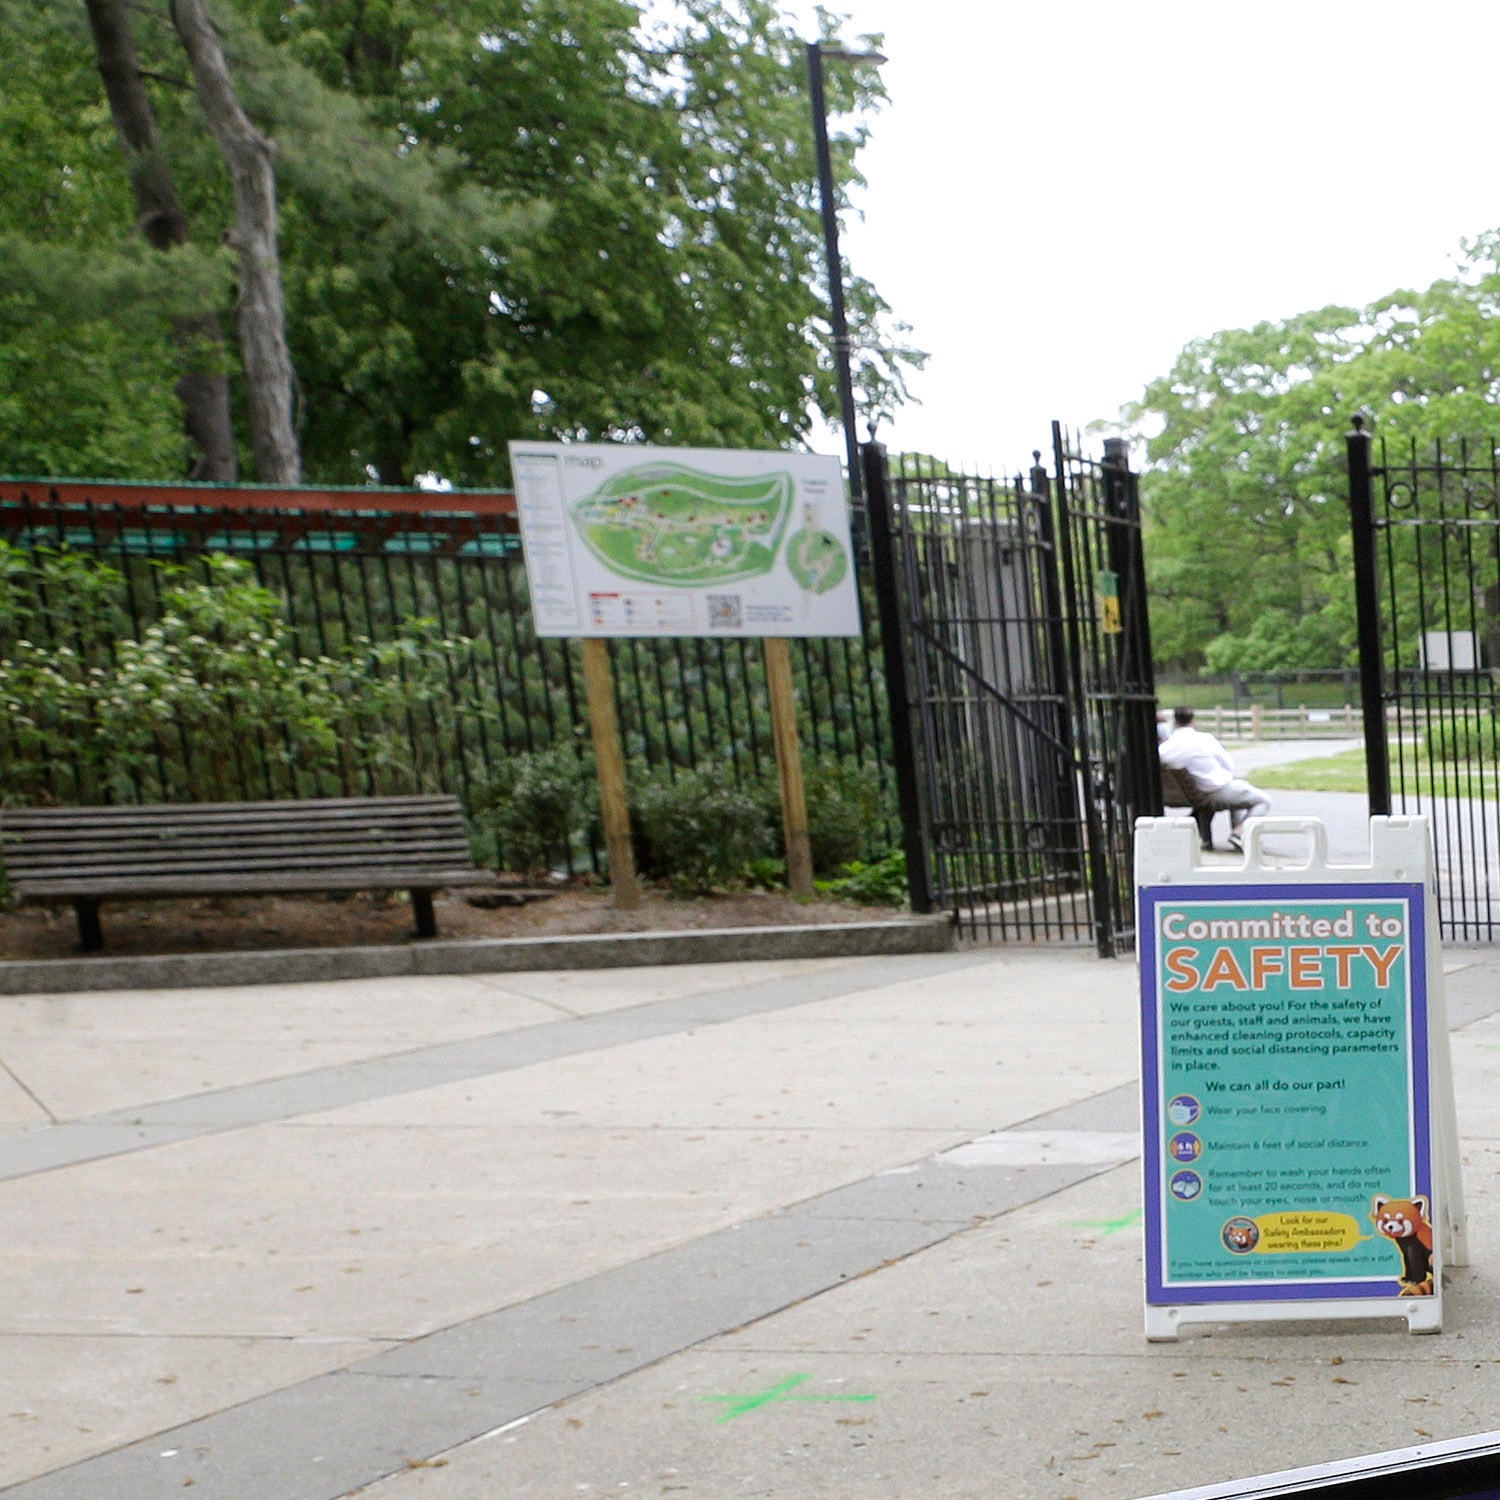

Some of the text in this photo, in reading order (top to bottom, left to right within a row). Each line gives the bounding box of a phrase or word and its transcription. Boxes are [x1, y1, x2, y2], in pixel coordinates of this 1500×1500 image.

[1161, 909, 1402, 942] Committed to
[1166, 945, 1402, 990] SAFETY
[1168, 1001, 1190, 1013] We
[1191, 1003, 1218, 1012] care
[1220, 999, 1257, 1012] about
[1286, 999, 1307, 1011] For
[1308, 998, 1330, 1011] the
[1330, 997, 1368, 1012] safety
[1367, 997, 1382, 1010] of
[1169, 1018, 1191, 1027] our
[1237, 1013, 1264, 1027] staff
[1265, 1013, 1290, 1026] and
[1341, 1015, 1361, 1024] we
[1362, 1011, 1392, 1024] have
[1169, 1028, 1230, 1042] enhanced
[1230, 1028, 1283, 1043] cleaning
[1345, 1027, 1396, 1042] capacity
[1203, 1079, 1227, 1092] We
[1228, 1082, 1252, 1092] can
[1253, 1078, 1270, 1091] all
[1270, 1078, 1290, 1091] do
[1290, 1081, 1313, 1091] our
